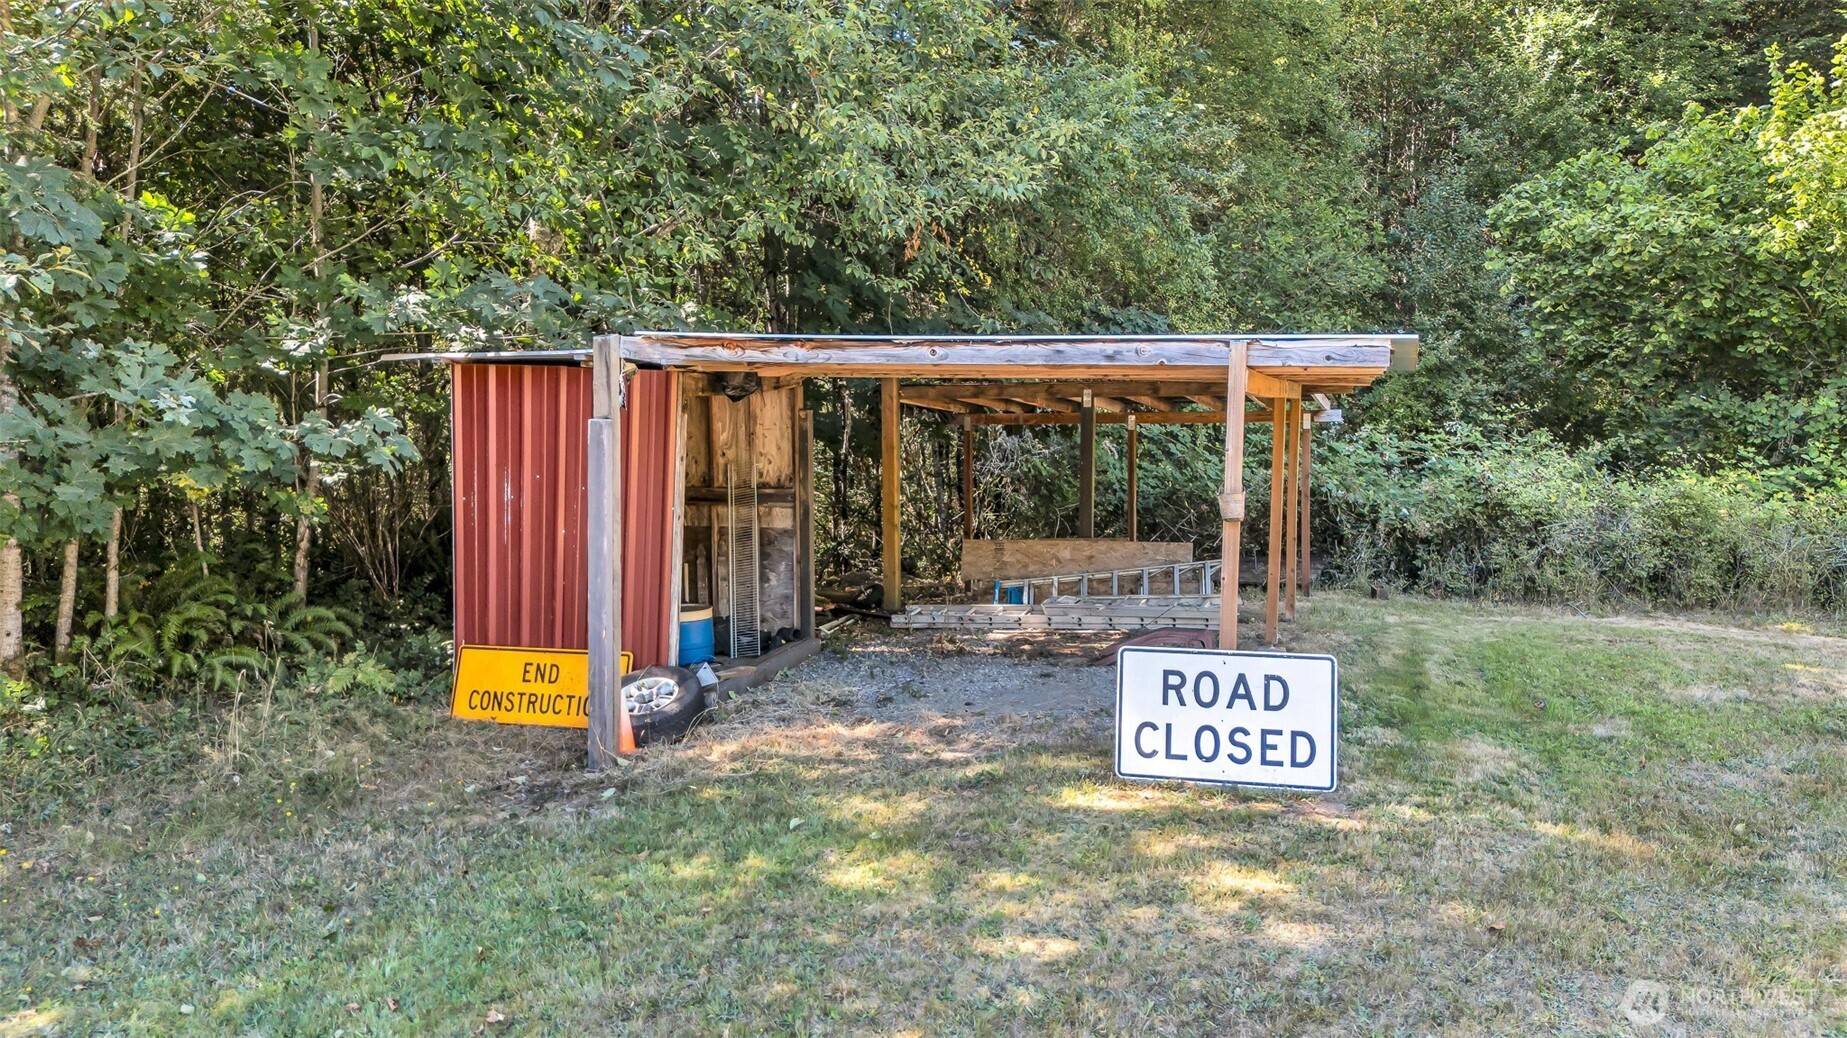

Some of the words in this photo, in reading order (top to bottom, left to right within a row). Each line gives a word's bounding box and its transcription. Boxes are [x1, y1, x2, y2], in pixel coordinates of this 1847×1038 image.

[521, 662, 560, 684] END
[1161, 668, 1290, 711] ROAD
[468, 689, 589, 717] CONSTRUCTIO
[1134, 720, 1317, 769] CLOSED
